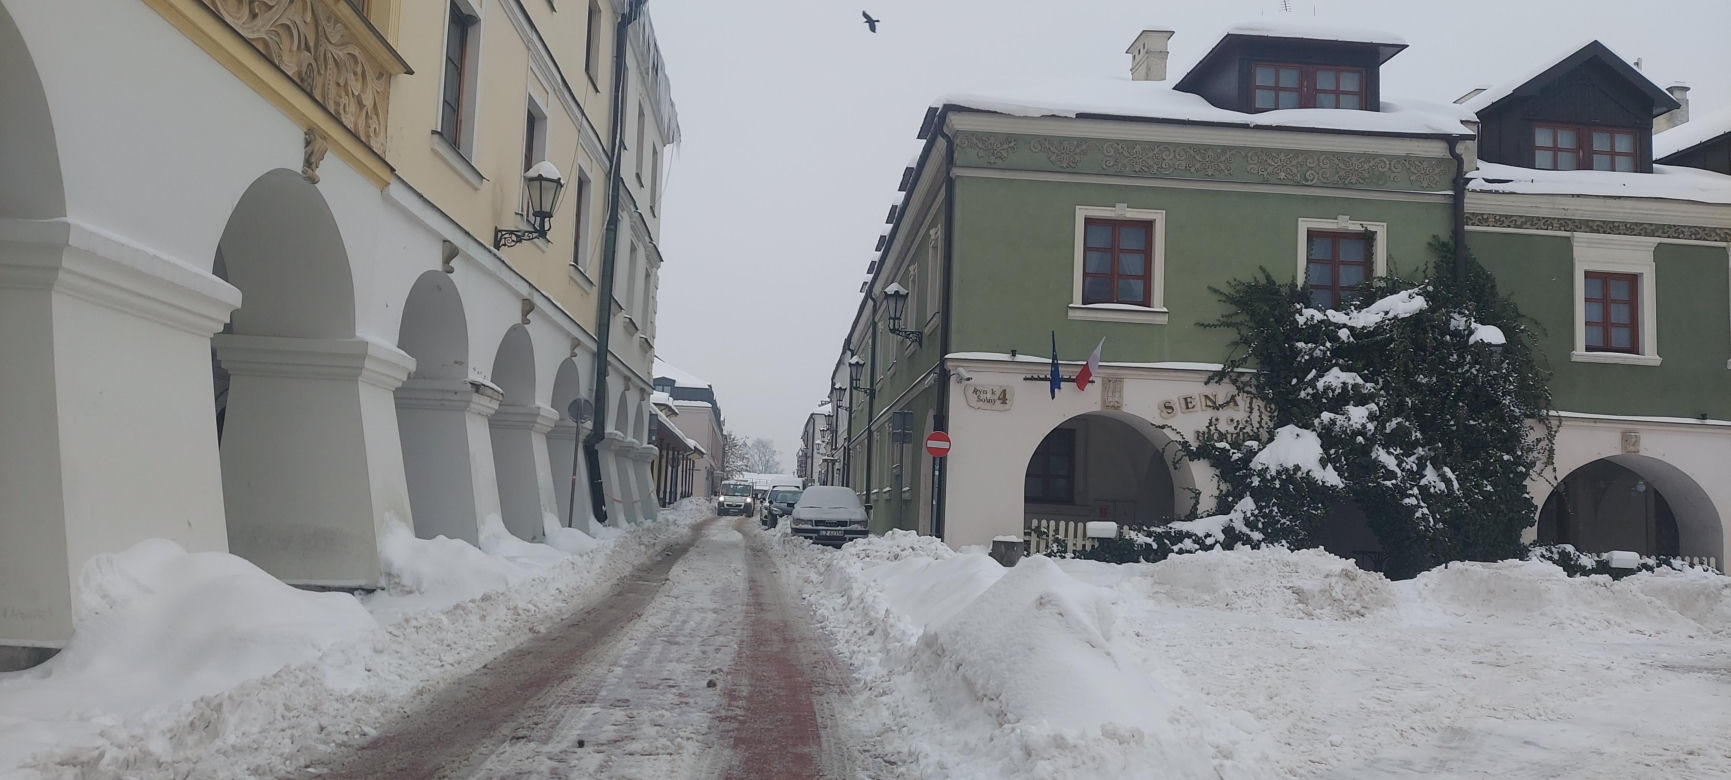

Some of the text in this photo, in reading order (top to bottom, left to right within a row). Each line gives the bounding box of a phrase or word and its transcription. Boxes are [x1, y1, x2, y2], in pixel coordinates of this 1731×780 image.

[972, 387, 997, 396] Rynk
[997, 388, 1008, 405] 4
[1161, 392, 1278, 416] SENATO
